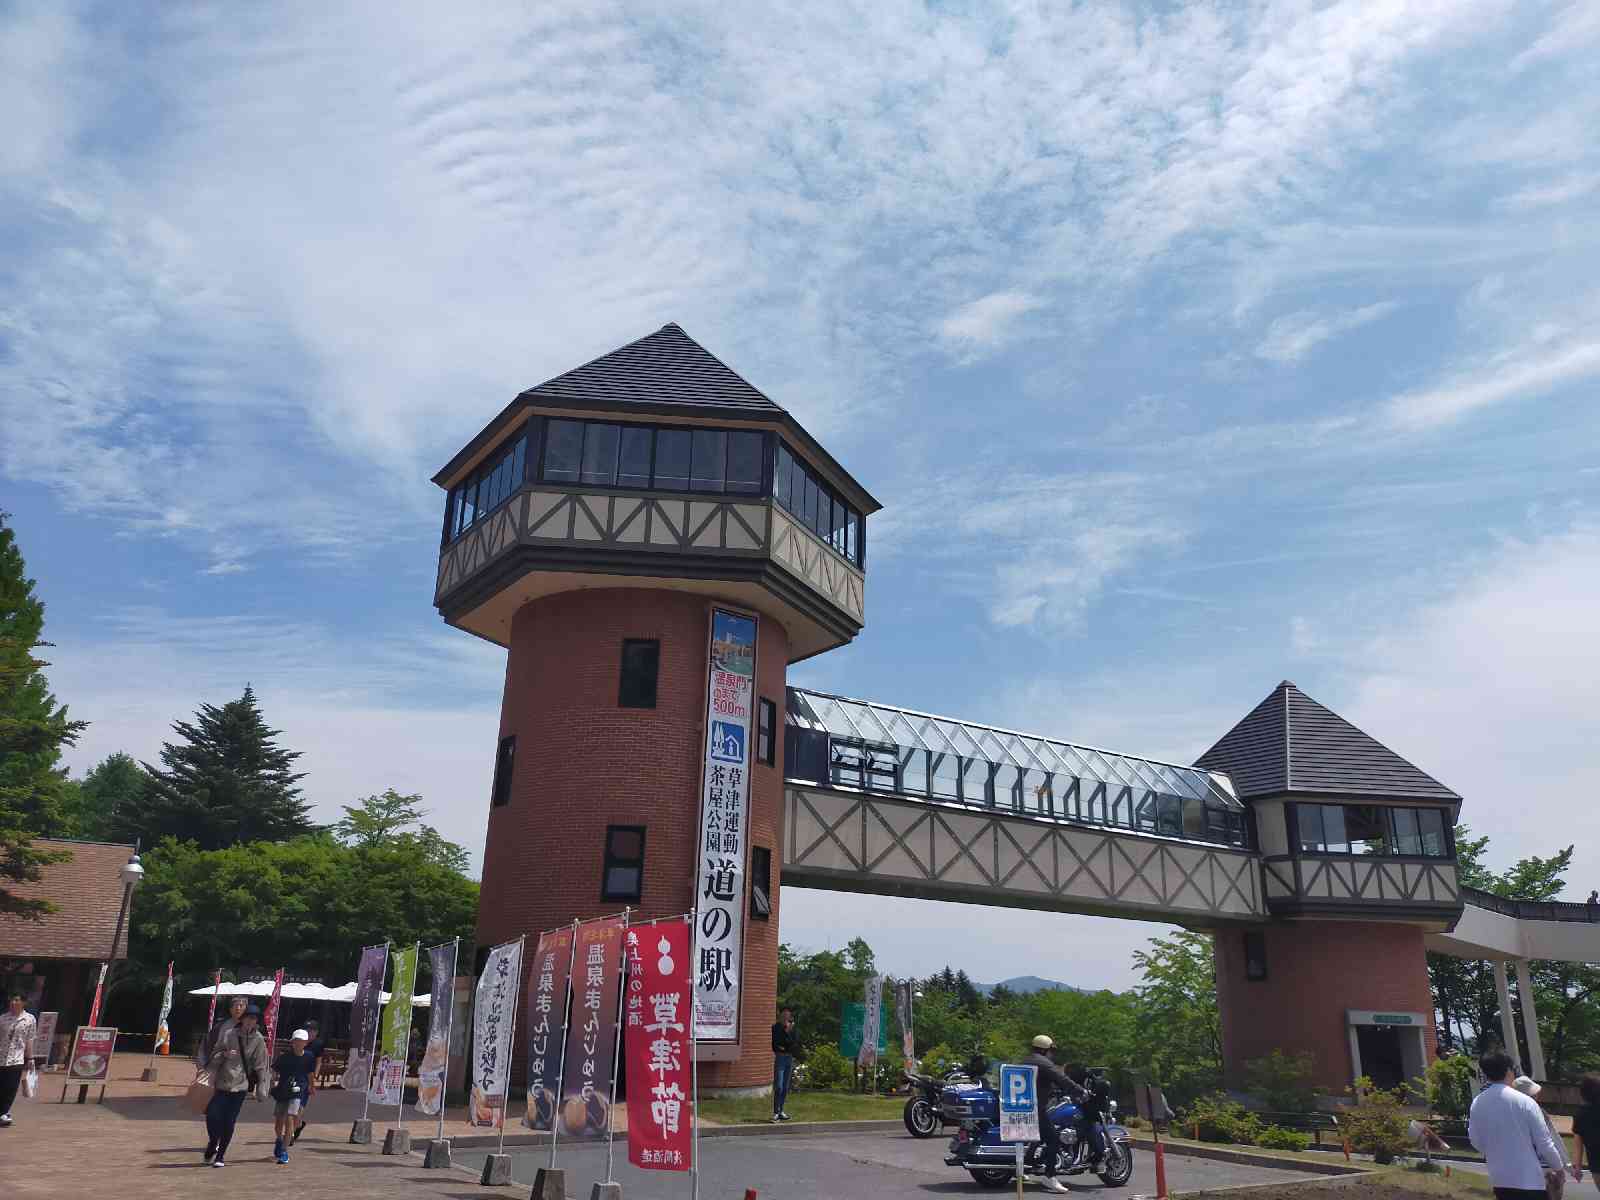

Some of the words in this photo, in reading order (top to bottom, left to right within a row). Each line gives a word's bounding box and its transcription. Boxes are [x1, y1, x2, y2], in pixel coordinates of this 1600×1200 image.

[713, 698, 745, 717] 500m
[705, 764, 726, 853] 茶屋公園
[722, 767, 743, 855] 草津運動
[699, 858, 738, 993] 道の駅
[1009, 1073, 1027, 1106] P
